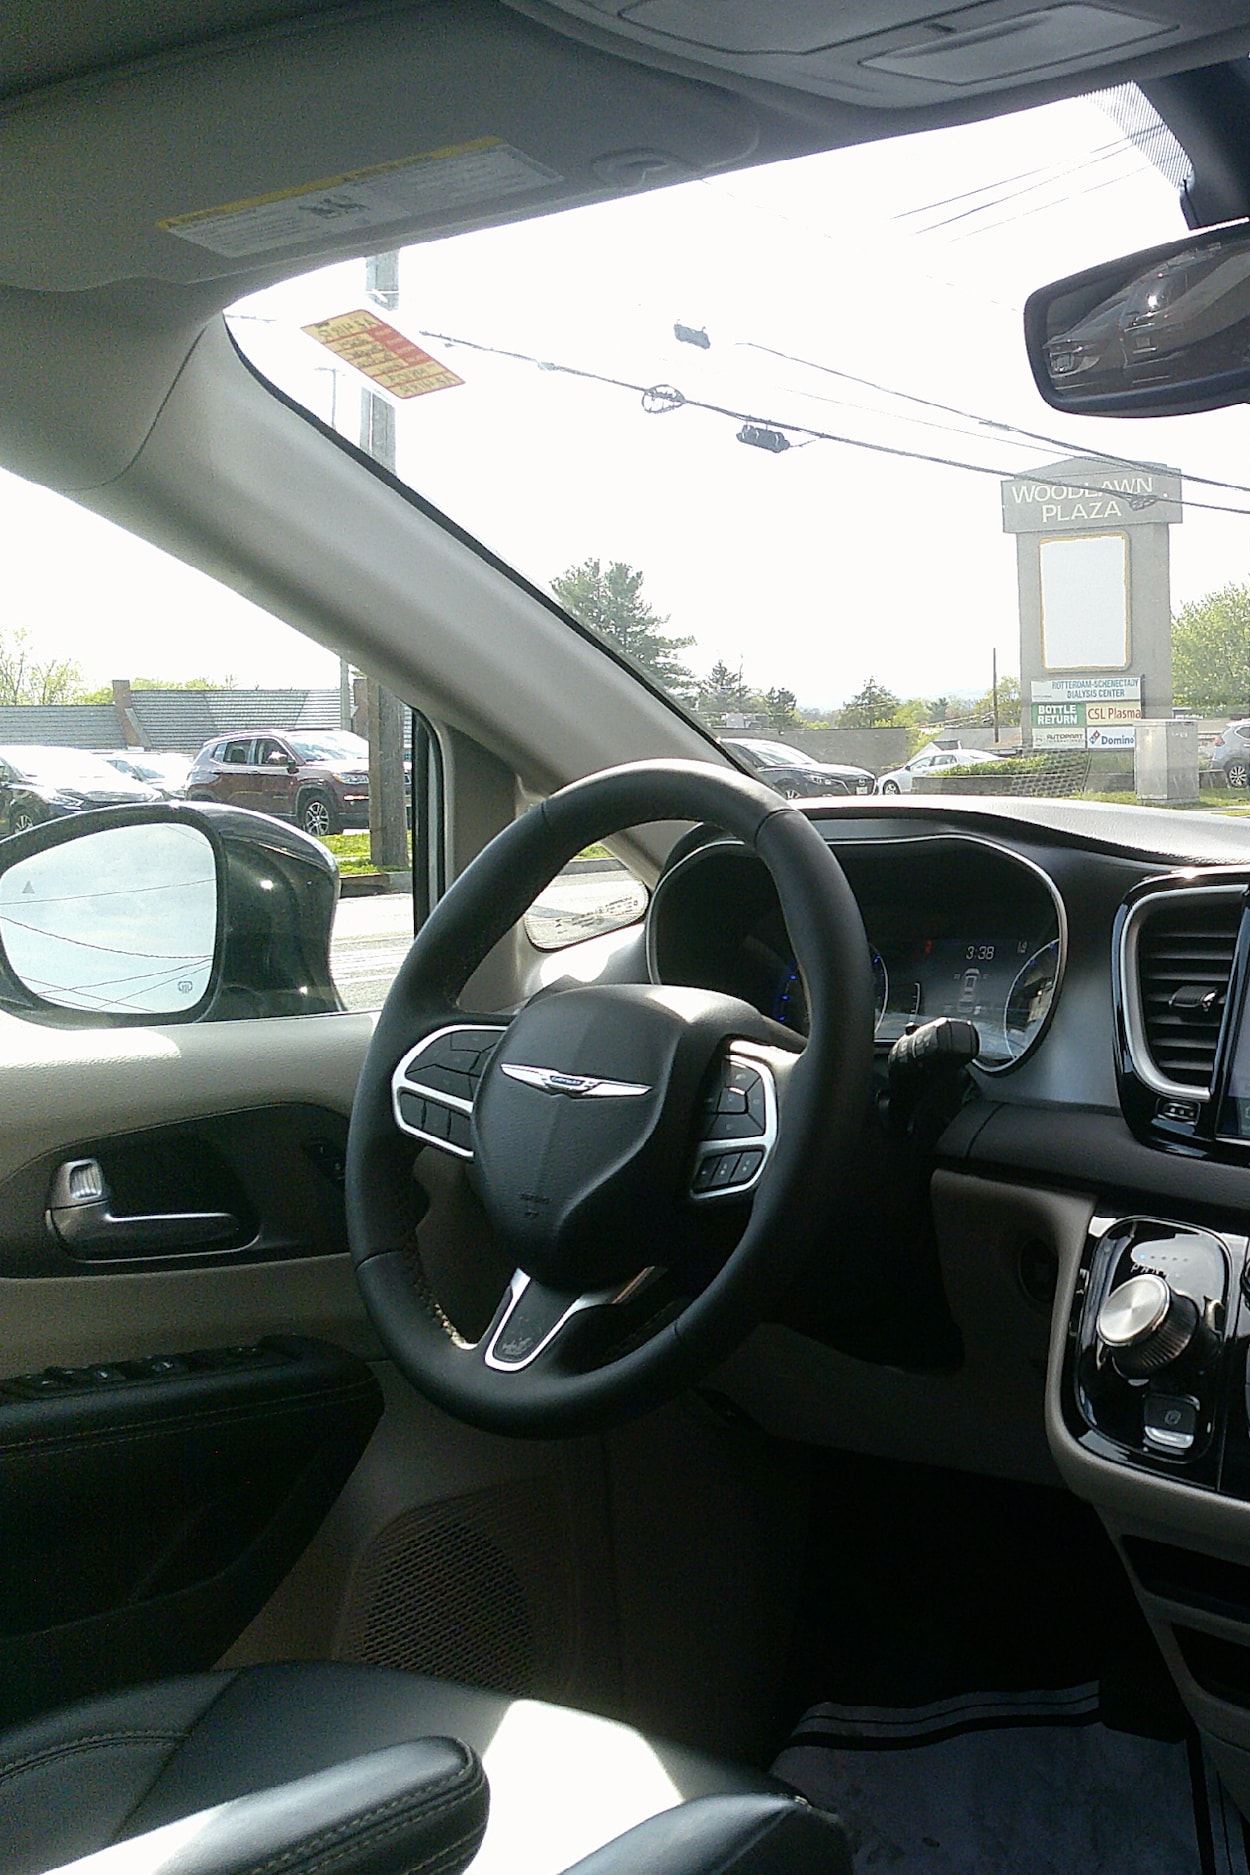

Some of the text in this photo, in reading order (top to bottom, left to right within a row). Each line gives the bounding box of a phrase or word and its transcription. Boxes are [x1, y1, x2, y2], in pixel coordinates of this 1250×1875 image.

[1011, 478, 1153, 503] WOODLAWN
[1042, 501, 1122, 523] PLAZA
[1052, 678, 1139, 690] ROTTERDAM-SCHENECTADY
[1067, 689, 1125, 699] DIALYSIS CENTER
[1038, 704, 1077, 715] BOTTLE
[1088, 707, 1141, 720] CSL Plasma
[1037, 715, 1078, 725] RETURN
[966, 946, 995, 960] 3:38
